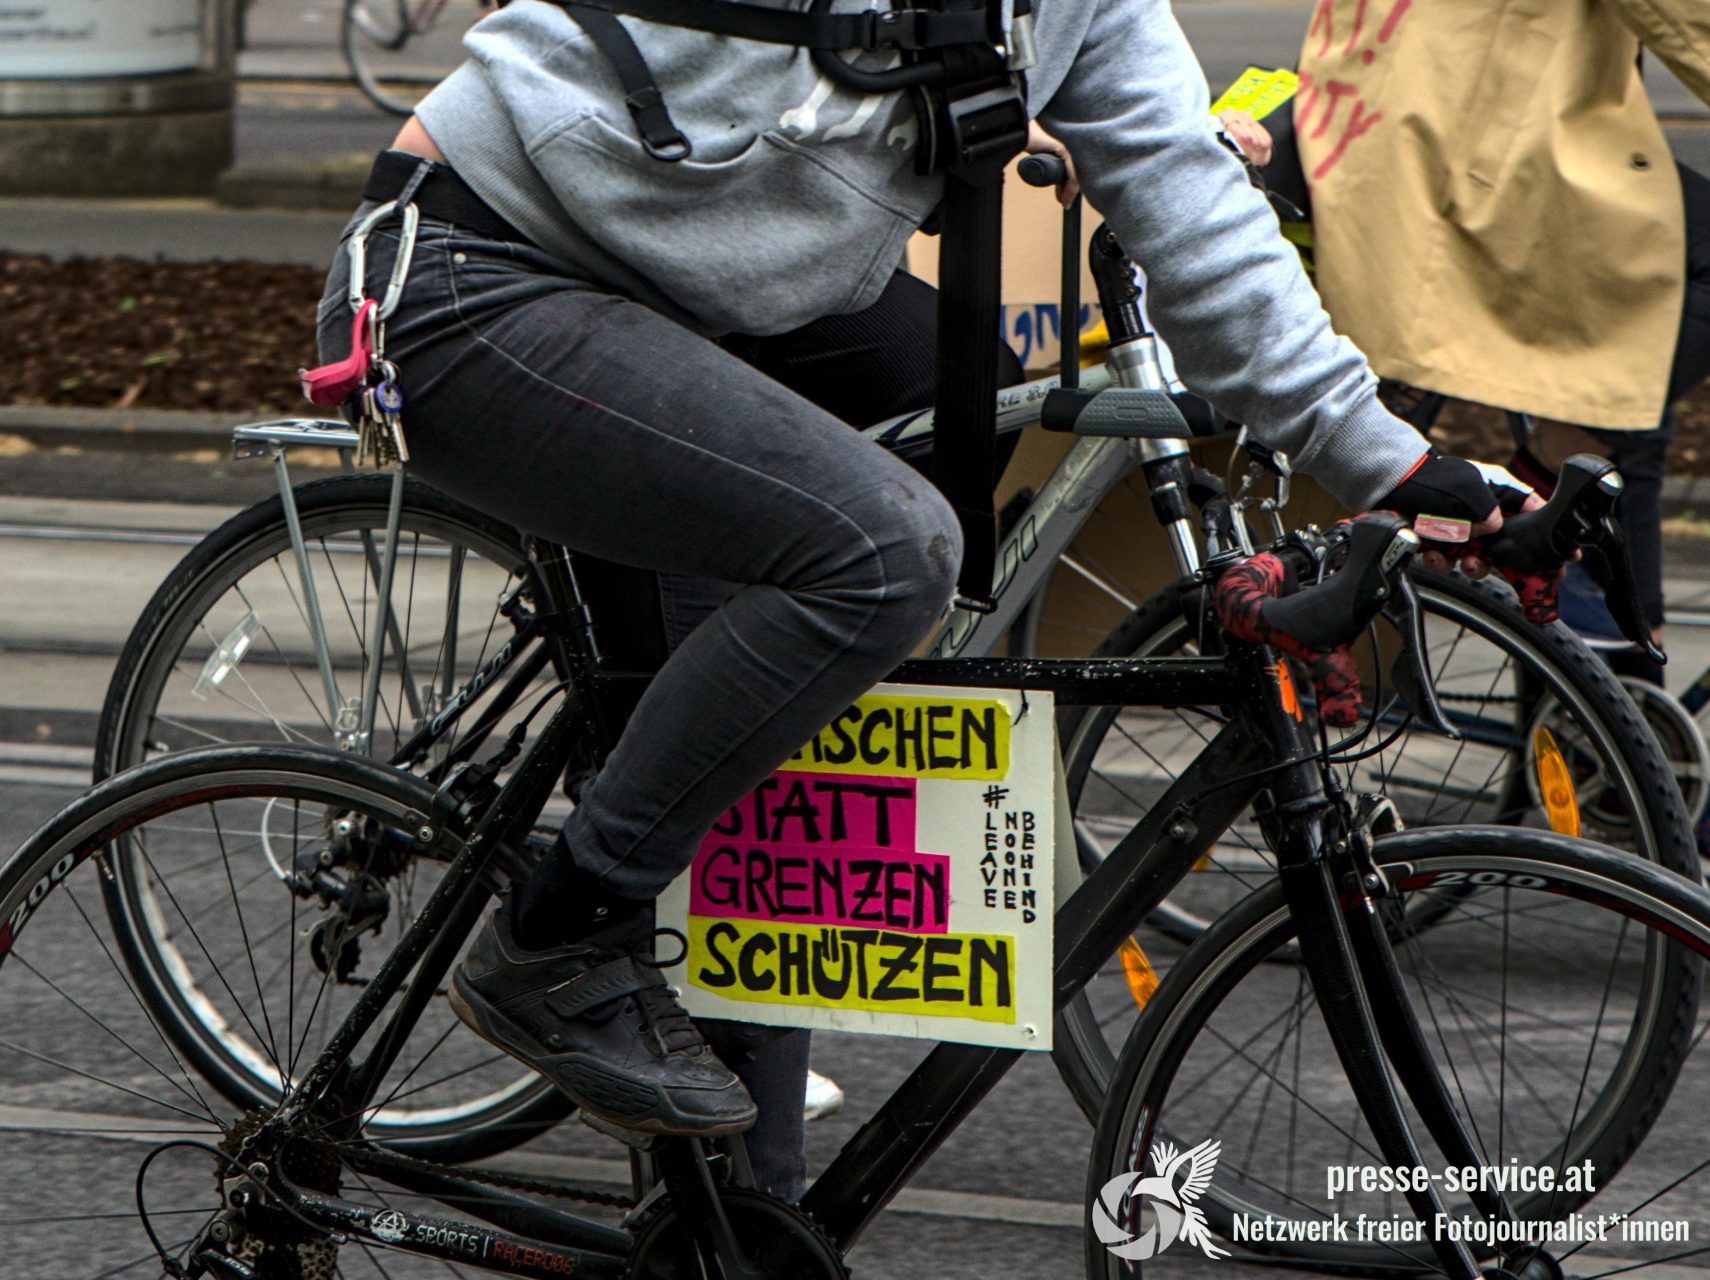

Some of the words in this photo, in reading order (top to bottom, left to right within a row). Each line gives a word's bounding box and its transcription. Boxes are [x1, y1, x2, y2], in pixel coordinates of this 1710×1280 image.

[9, 852, 76, 937] 200
[700, 846, 946, 930] GRENZEN
[1021, 811, 1036, 924] BEHIND
[1430, 871, 1548, 889] 200
[698, 922, 1012, 1009] SCHÜTZEN
[416, 1224, 479, 1254] SPORTS
